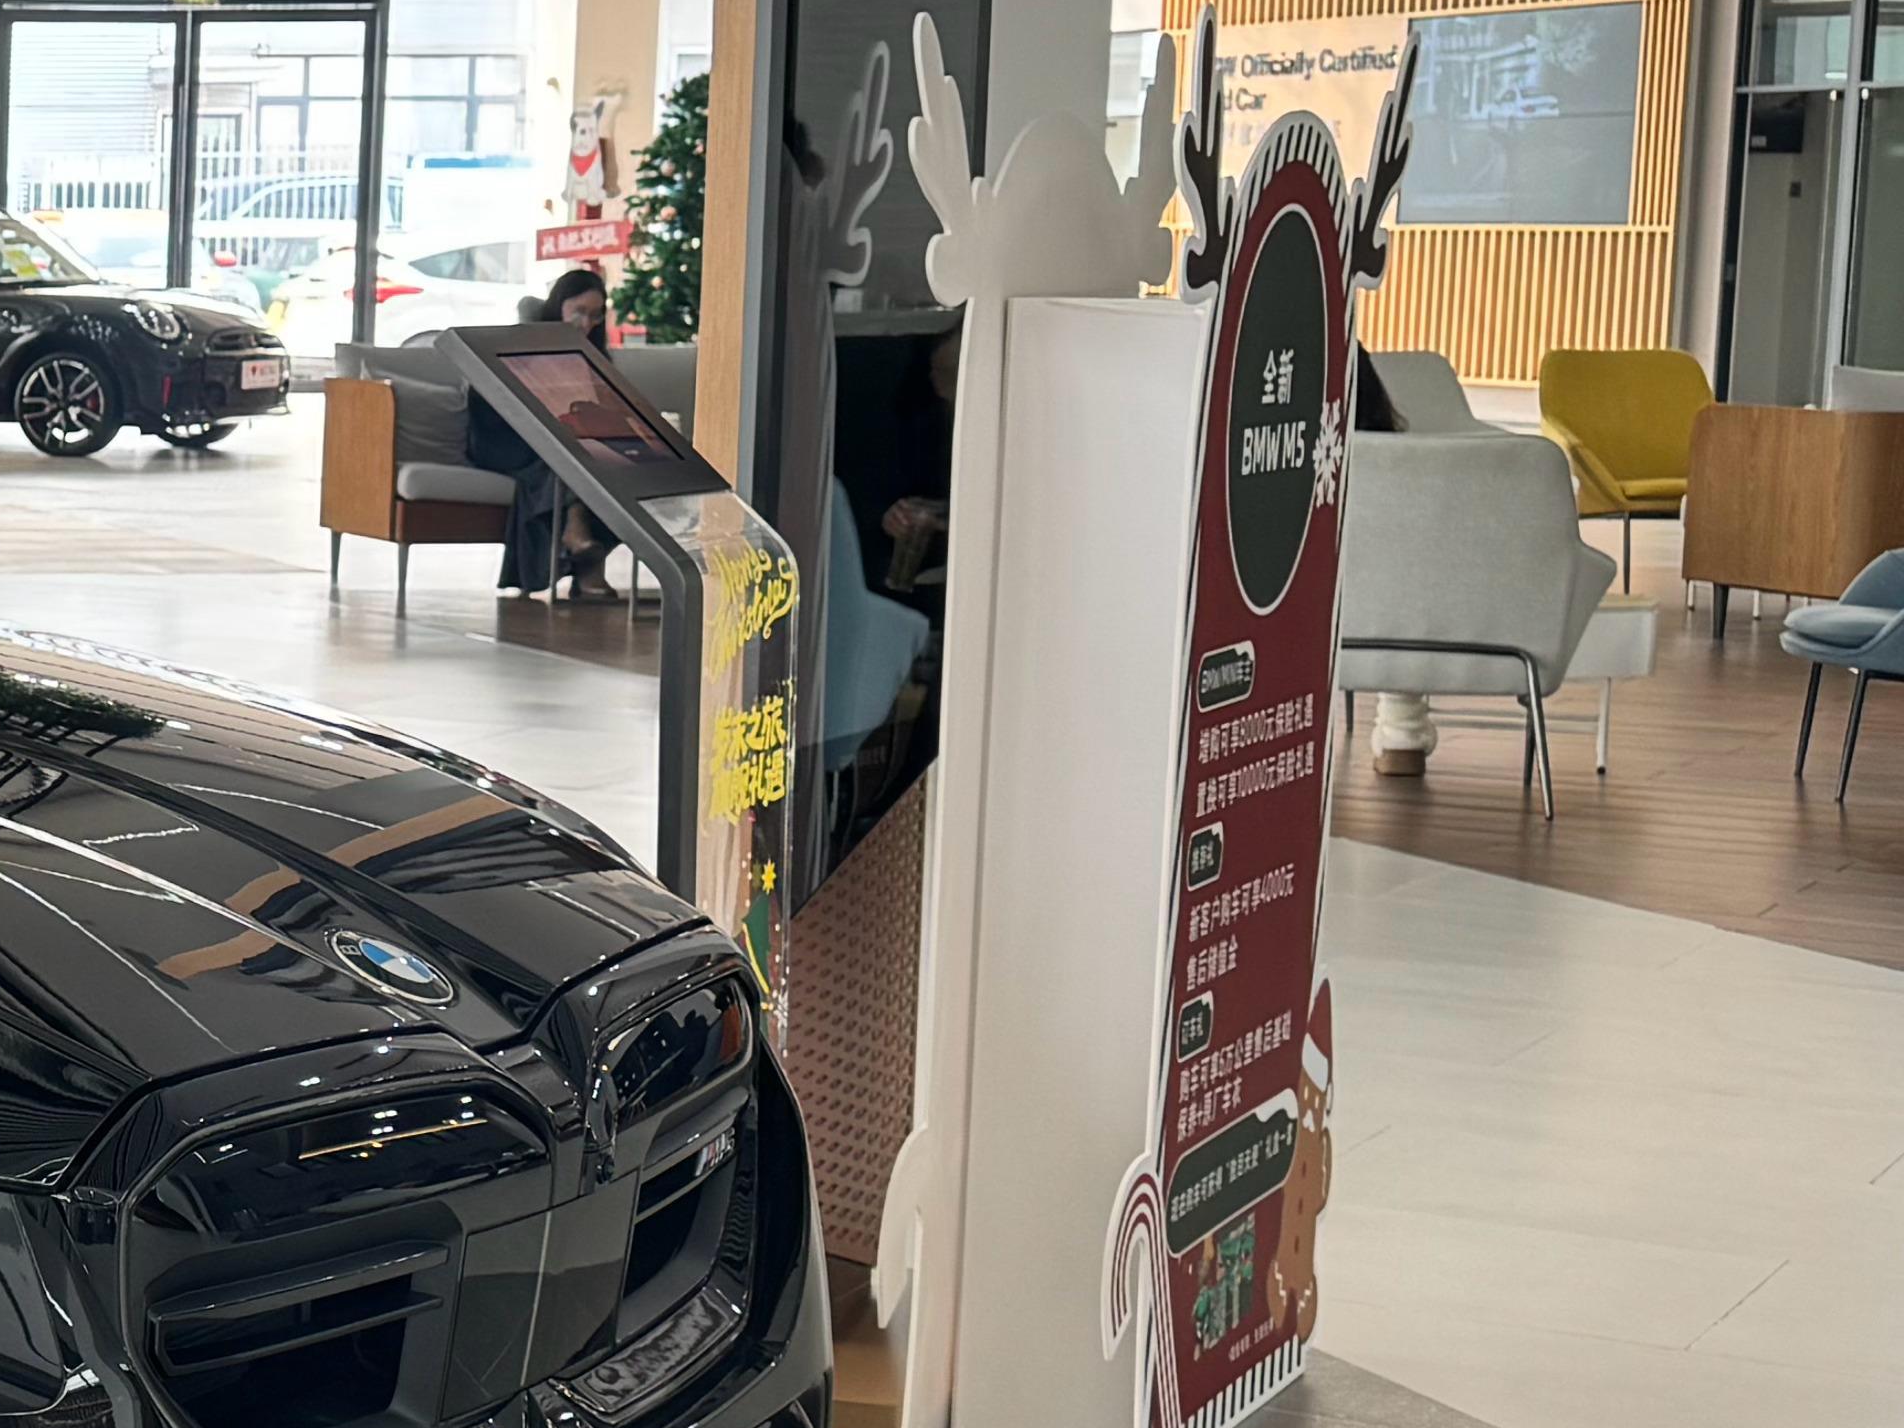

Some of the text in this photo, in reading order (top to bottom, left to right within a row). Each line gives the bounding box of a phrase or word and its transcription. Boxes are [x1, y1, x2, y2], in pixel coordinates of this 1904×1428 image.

[1261, 348, 1294, 405] 全新
[1241, 420, 1306, 476] BMW M5
